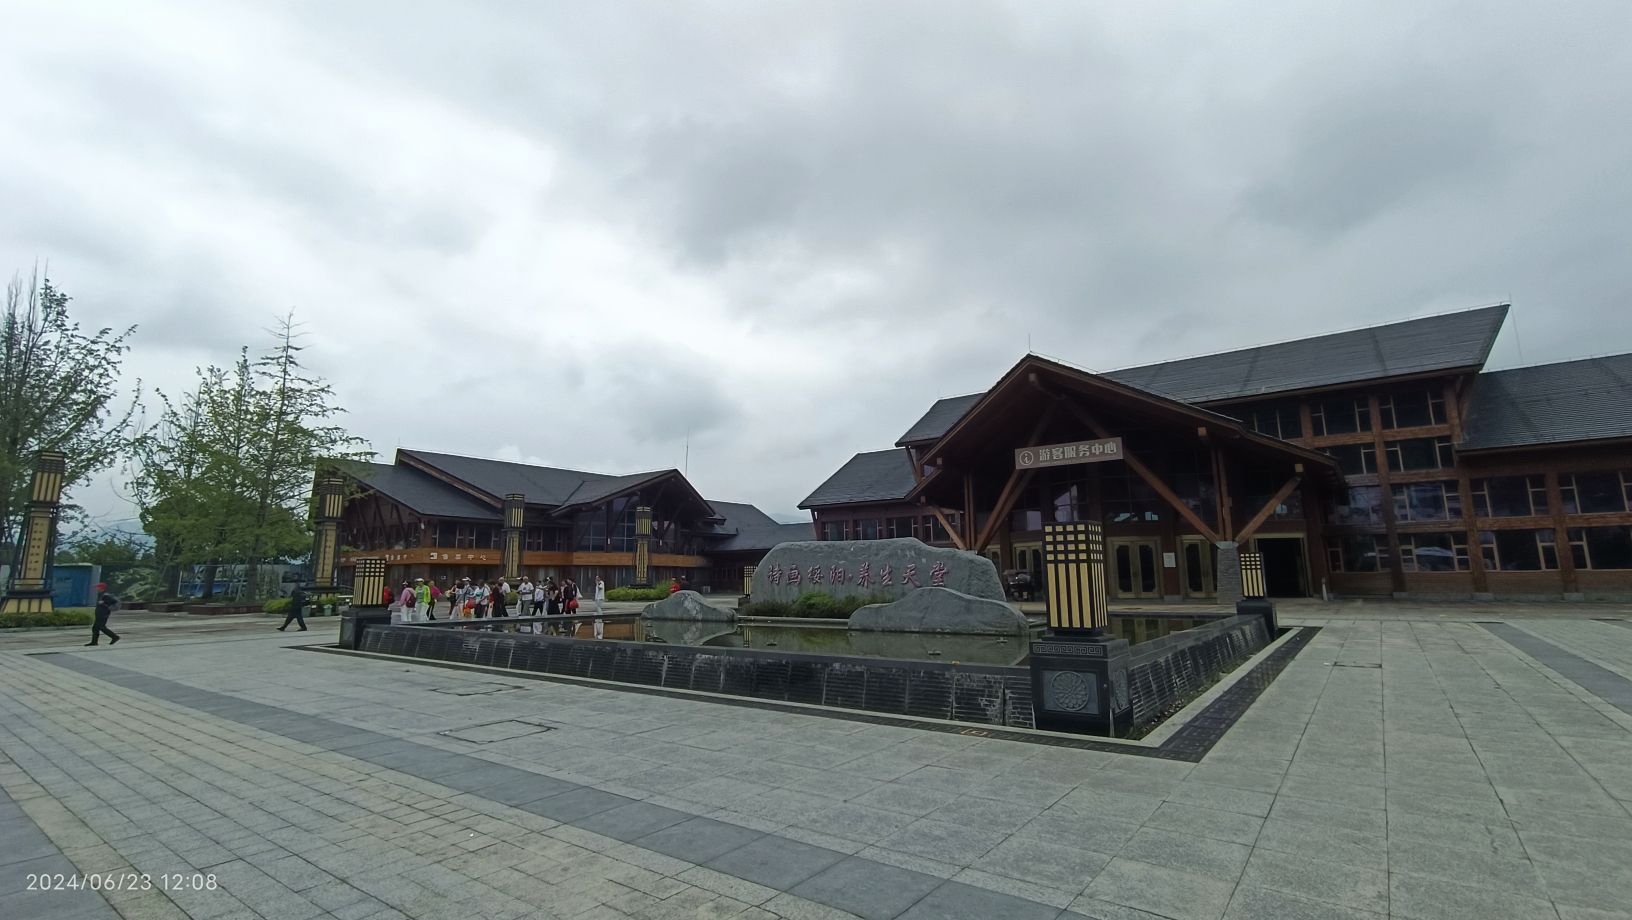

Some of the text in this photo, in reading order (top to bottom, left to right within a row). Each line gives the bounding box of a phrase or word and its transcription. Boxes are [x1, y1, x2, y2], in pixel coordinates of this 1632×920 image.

[1039, 441, 1117, 461] 游客服务中心
